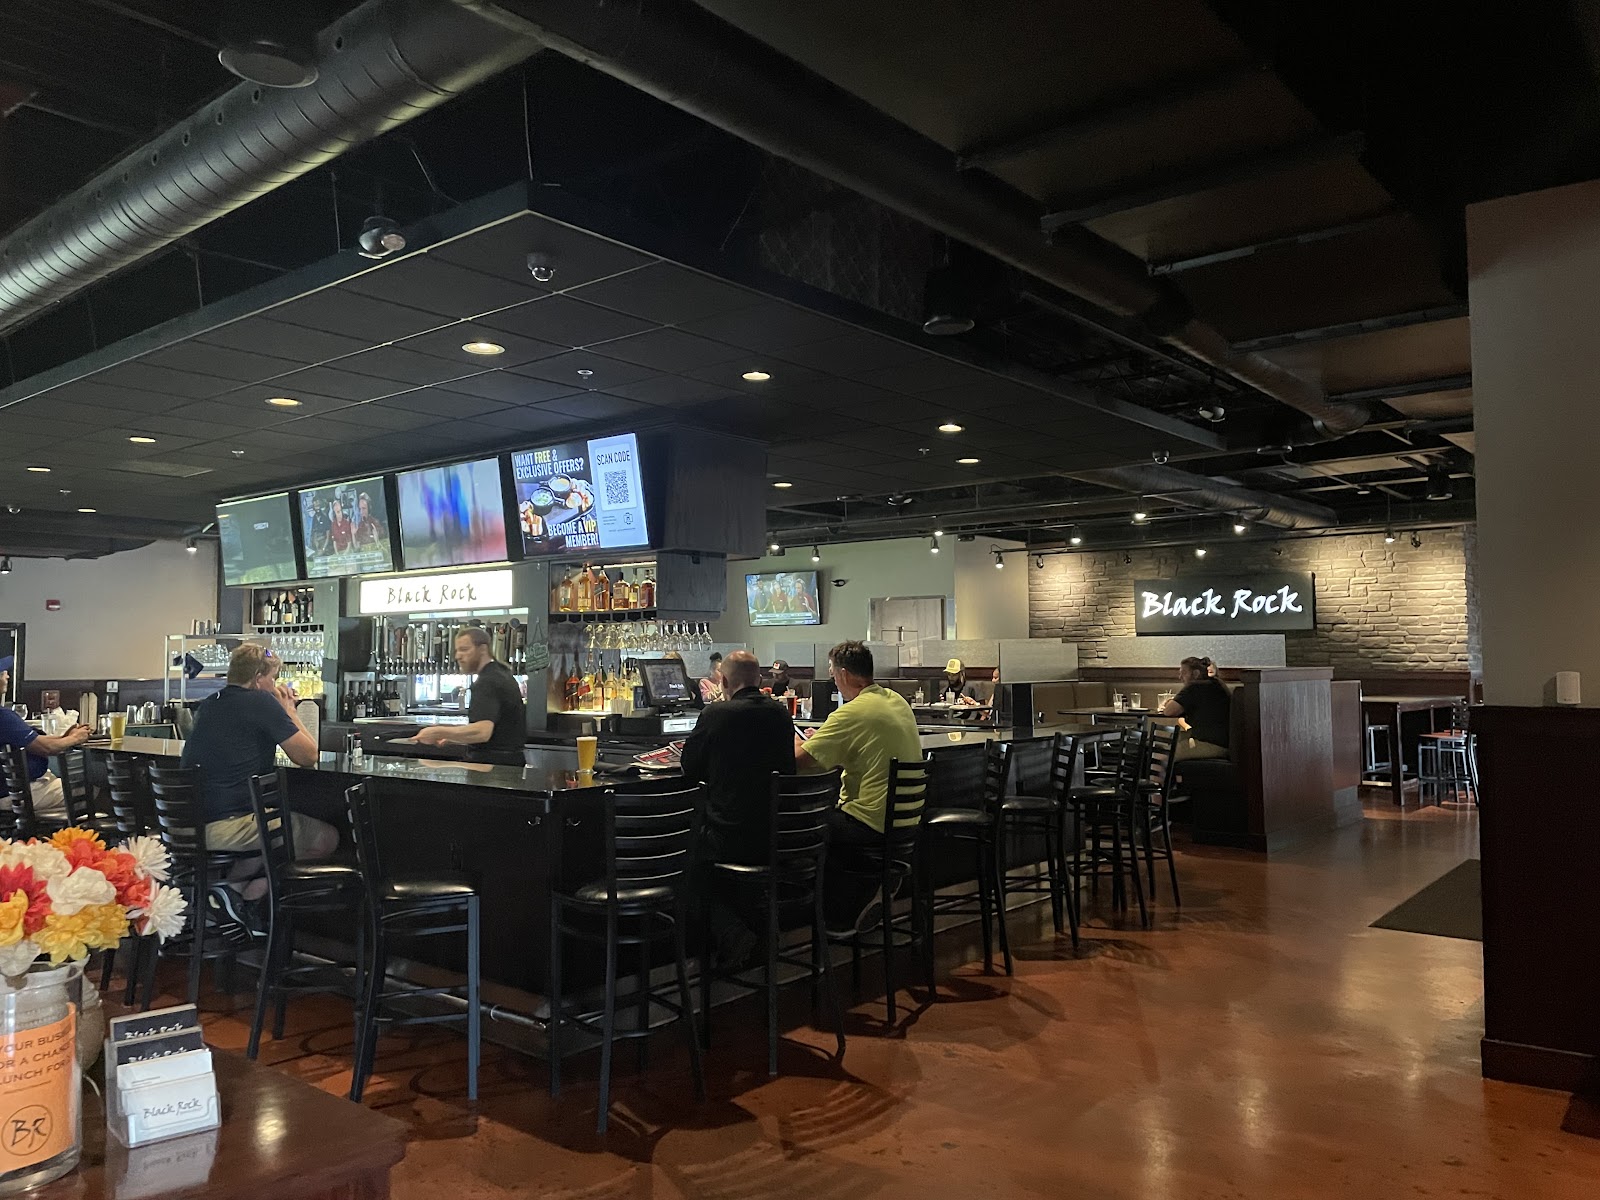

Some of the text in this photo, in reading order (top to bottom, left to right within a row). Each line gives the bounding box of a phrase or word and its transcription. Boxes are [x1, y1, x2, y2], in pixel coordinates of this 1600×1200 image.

[514, 449, 558, 467] WANT FREE &
[597, 450, 631, 466] SCAN CODE
[516, 457, 584, 479] EXCLUSIVE OFFERS?
[548, 521, 577, 536] BECOME
[578, 523, 584, 534] A
[584, 520, 597, 533] VIP
[565, 533, 600, 548] MEMBER!
[387, 583, 477, 605] Black Rock
[1141, 585, 1303, 619] Black Rock
[19, 1057, 29, 1066] A
[143, 1104, 175, 1119] Black
[176, 1098, 202, 1115] Rock
[11, 1118, 47, 1148] BR
